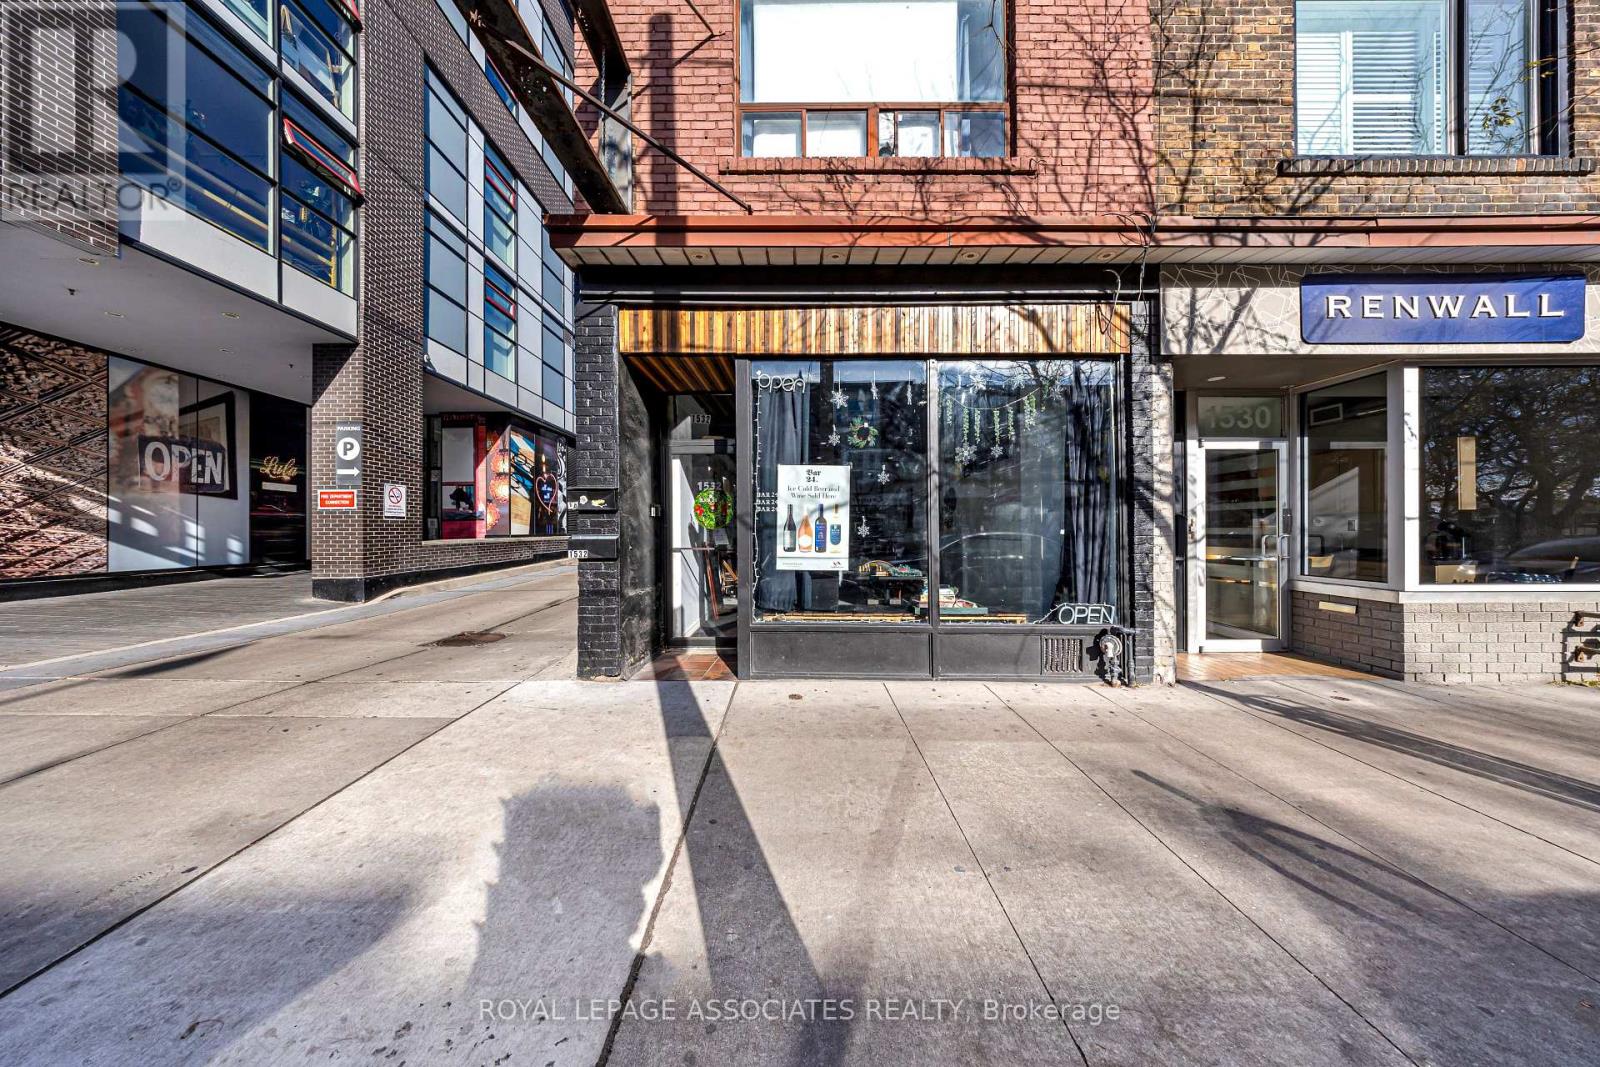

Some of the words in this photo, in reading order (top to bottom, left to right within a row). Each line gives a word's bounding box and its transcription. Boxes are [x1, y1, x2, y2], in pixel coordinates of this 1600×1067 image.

[1326, 293, 1565, 320] RENWALL
[757, 373, 806, 393] open
[1206, 405, 1272, 429] 1530
[144, 441, 224, 486] OPEN
[697, 481, 722, 491] 1532
[569, 550, 588, 558] 1532
[1059, 607, 1115, 624] OPEN
